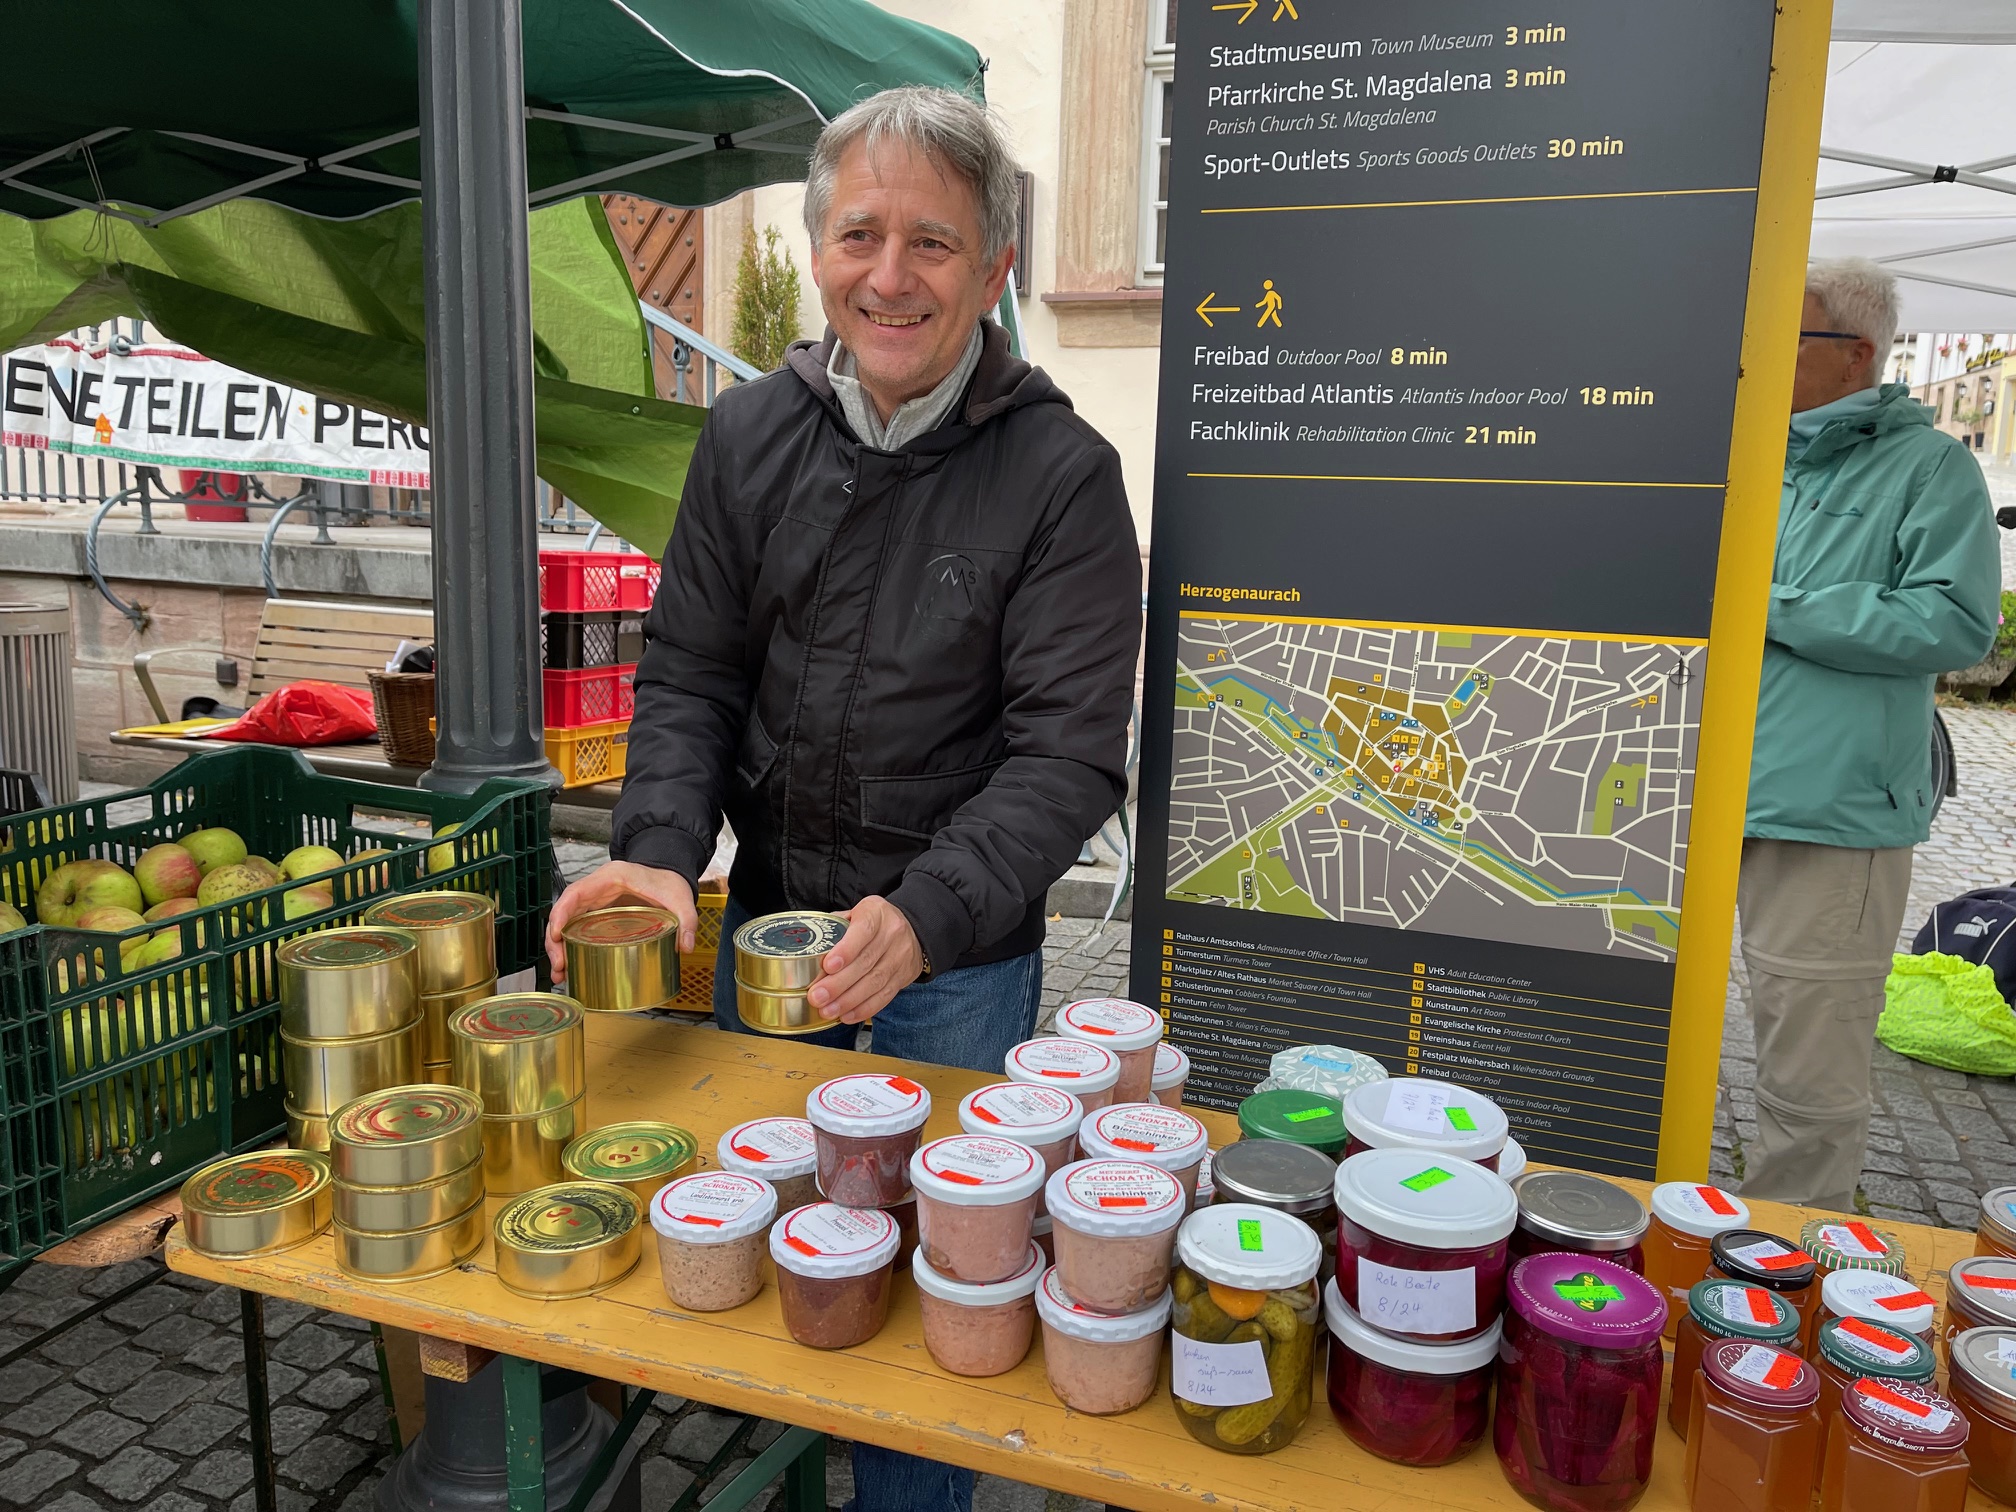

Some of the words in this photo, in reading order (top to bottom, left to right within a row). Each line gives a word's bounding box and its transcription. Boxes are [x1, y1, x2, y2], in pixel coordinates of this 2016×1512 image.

[1210, 37, 1362, 68] Stadtmuseum
[1370, 36, 1414, 56] Town
[1419, 30, 1493, 52] Museum
[1505, 26, 1518, 46] 3
[1524, 22, 1566, 44] min
[1208, 79, 1324, 108] Pfarrkirche
[1331, 77, 1359, 100] St.
[1366, 70, 1492, 100] Magdalena
[1505, 68, 1518, 88] 3
[1524, 65, 1566, 87] min
[1207, 116, 1255, 136] Parish
[1260, 112, 1314, 132] Church
[1318, 110, 1338, 129] St.
[1343, 107, 1437, 130] Magdalena
[1204, 150, 1350, 179] Sport-Outlets
[1356, 149, 1410, 170] Sports
[1415, 146, 1469, 166] Goods
[1473, 142, 1536, 162] Outlets
[1547, 138, 1576, 159] 30
[1582, 136, 1624, 157] min
[1194, 346, 1270, 368] Freibad
[1276, 348, 1341, 366] Outdoor
[1346, 348, 1382, 366] Pool
[1390, 348, 1404, 366] 8
[1409, 346, 1448, 366] min
[1192, 384, 1304, 404] Freizeitbad
[1310, 384, 1394, 405] Atlantis
[1400, 387, 1464, 405] Atlantis
[1468, 388, 1524, 406] Indoor
[1528, 388, 1568, 406] Pool
[1580, 388, 1606, 406] 18
[1612, 386, 1654, 406] min
[112, 375, 293, 441] TEILEN
[1190, 421, 1290, 442] Fachklinik
[1296, 425, 1408, 444] Rehabilitation
[1411, 426, 1455, 444] Clinic
[1465, 426, 1491, 445] 21
[1496, 426, 1537, 446] min
[1180, 583, 1301, 602] Herzogenaurach
[1176, 932, 1205, 943] Rathaus
[1210, 937, 1255, 950] Amtsschloss
[1257, 944, 1306, 957] Administrative
[1308, 950, 1328, 960] Office
[1334, 954, 1352, 962] Town
[1352, 956, 1368, 965] Hall
[1251, 959, 1272, 968] Tower
[1175, 964, 1212, 976] Marktplatz
[1217, 970, 1236, 980] Altes
[1237, 974, 1266, 984] Rathaus
[1268, 978, 1293, 988] Market
[1294, 982, 1318, 992] Square
[1324, 985, 1336, 994] Old
[1338, 987, 1356, 997] Town
[1357, 989, 1372, 998] Hall
[1428, 967, 1446, 976] VHS
[1447, 970, 1466, 979] Adult
[1468, 972, 1506, 984] Education
[1507, 978, 1532, 987] Center
[1174, 980, 1234, 995] Schusterbrunnen
[1235, 989, 1266, 1000] Cobbler's
[1267, 994, 1296, 1004] Fountain
[1427, 983, 1486, 998] Stadtbibliothek
[1488, 992, 1511, 1002] Public
[1512, 995, 1540, 1007] Library
[1174, 996, 1208, 1007] Fehnturm
[1209, 1001, 1226, 1010] Fehn
[1227, 1004, 1247, 1013] Tower
[1426, 1000, 1468, 1012] Kunstraum
[1470, 1006, 1482, 1014] Art
[1484, 1009, 1506, 1018] Room
[1172, 1012, 1224, 1026] Kiliansbrunnen
[1236, 1021, 1258, 1032] Kilian's
[1260, 1025, 1290, 1036] Fountain
[1424, 1016, 1475, 1031] Evangelische
[1477, 1025, 1502, 1035] Kirche
[1503, 1028, 1543, 1041] Protestant
[1544, 1034, 1572, 1044] Church
[1172, 1027, 1210, 1040] Pfarrkirche
[1211, 1034, 1220, 1042] St.
[1222, 1036, 1260, 1048] Magdalena
[1262, 1042, 1284, 1052] Parish
[1424, 1034, 1470, 1048] Vereinshaus
[1472, 1041, 1494, 1051] Event
[1496, 1044, 1512, 1054] Hall
[1222, 1051, 1240, 1060] Town
[1241, 1054, 1270, 1066] Museum
[1422, 1050, 1458, 1062] Festplatz
[1460, 1056, 1510, 1070] Weihersbach
[1512, 1064, 1560, 1078] Weihersbach
[1562, 1071, 1595, 1083] Grounds
[1220, 1066, 1245, 1079] Chapel
[1247, 1071, 1252, 1079] of
[1421, 1066, 1450, 1078] Freibad
[1452, 1072, 1482, 1083] Outdoor
[1484, 1076, 1501, 1086] Pool
[1214, 1082, 1234, 1092] Music
[1235, 1085, 1255, 1095] Schoo
[1198, 1095, 1238, 1108] Bürgerhaus
[1498, 1095, 1525, 1107] Atlantis
[1526, 1100, 1551, 1110] Indoor
[1552, 1104, 1570, 1114] Pool
[1124, 1114, 1186, 1129] SCHONATH
[1507, 1114, 1523, 1124] oods
[1524, 1117, 1552, 1128] Outlets
[1112, 1125, 1181, 1141] Bierschinken
[1510, 1131, 1530, 1141] Clinic
[967, 1143, 1014, 1156] SCHONATH
[702, 1182, 748, 1192] SCHONATH
[1375, 1272, 1398, 1289] Rote
[1404, 1274, 1441, 1291] Beete
[1377, 1296, 1422, 1317] 8/24
[1708, 1323, 1724, 1335] DARBO
[1188, 1380, 1216, 1396] 8/24
